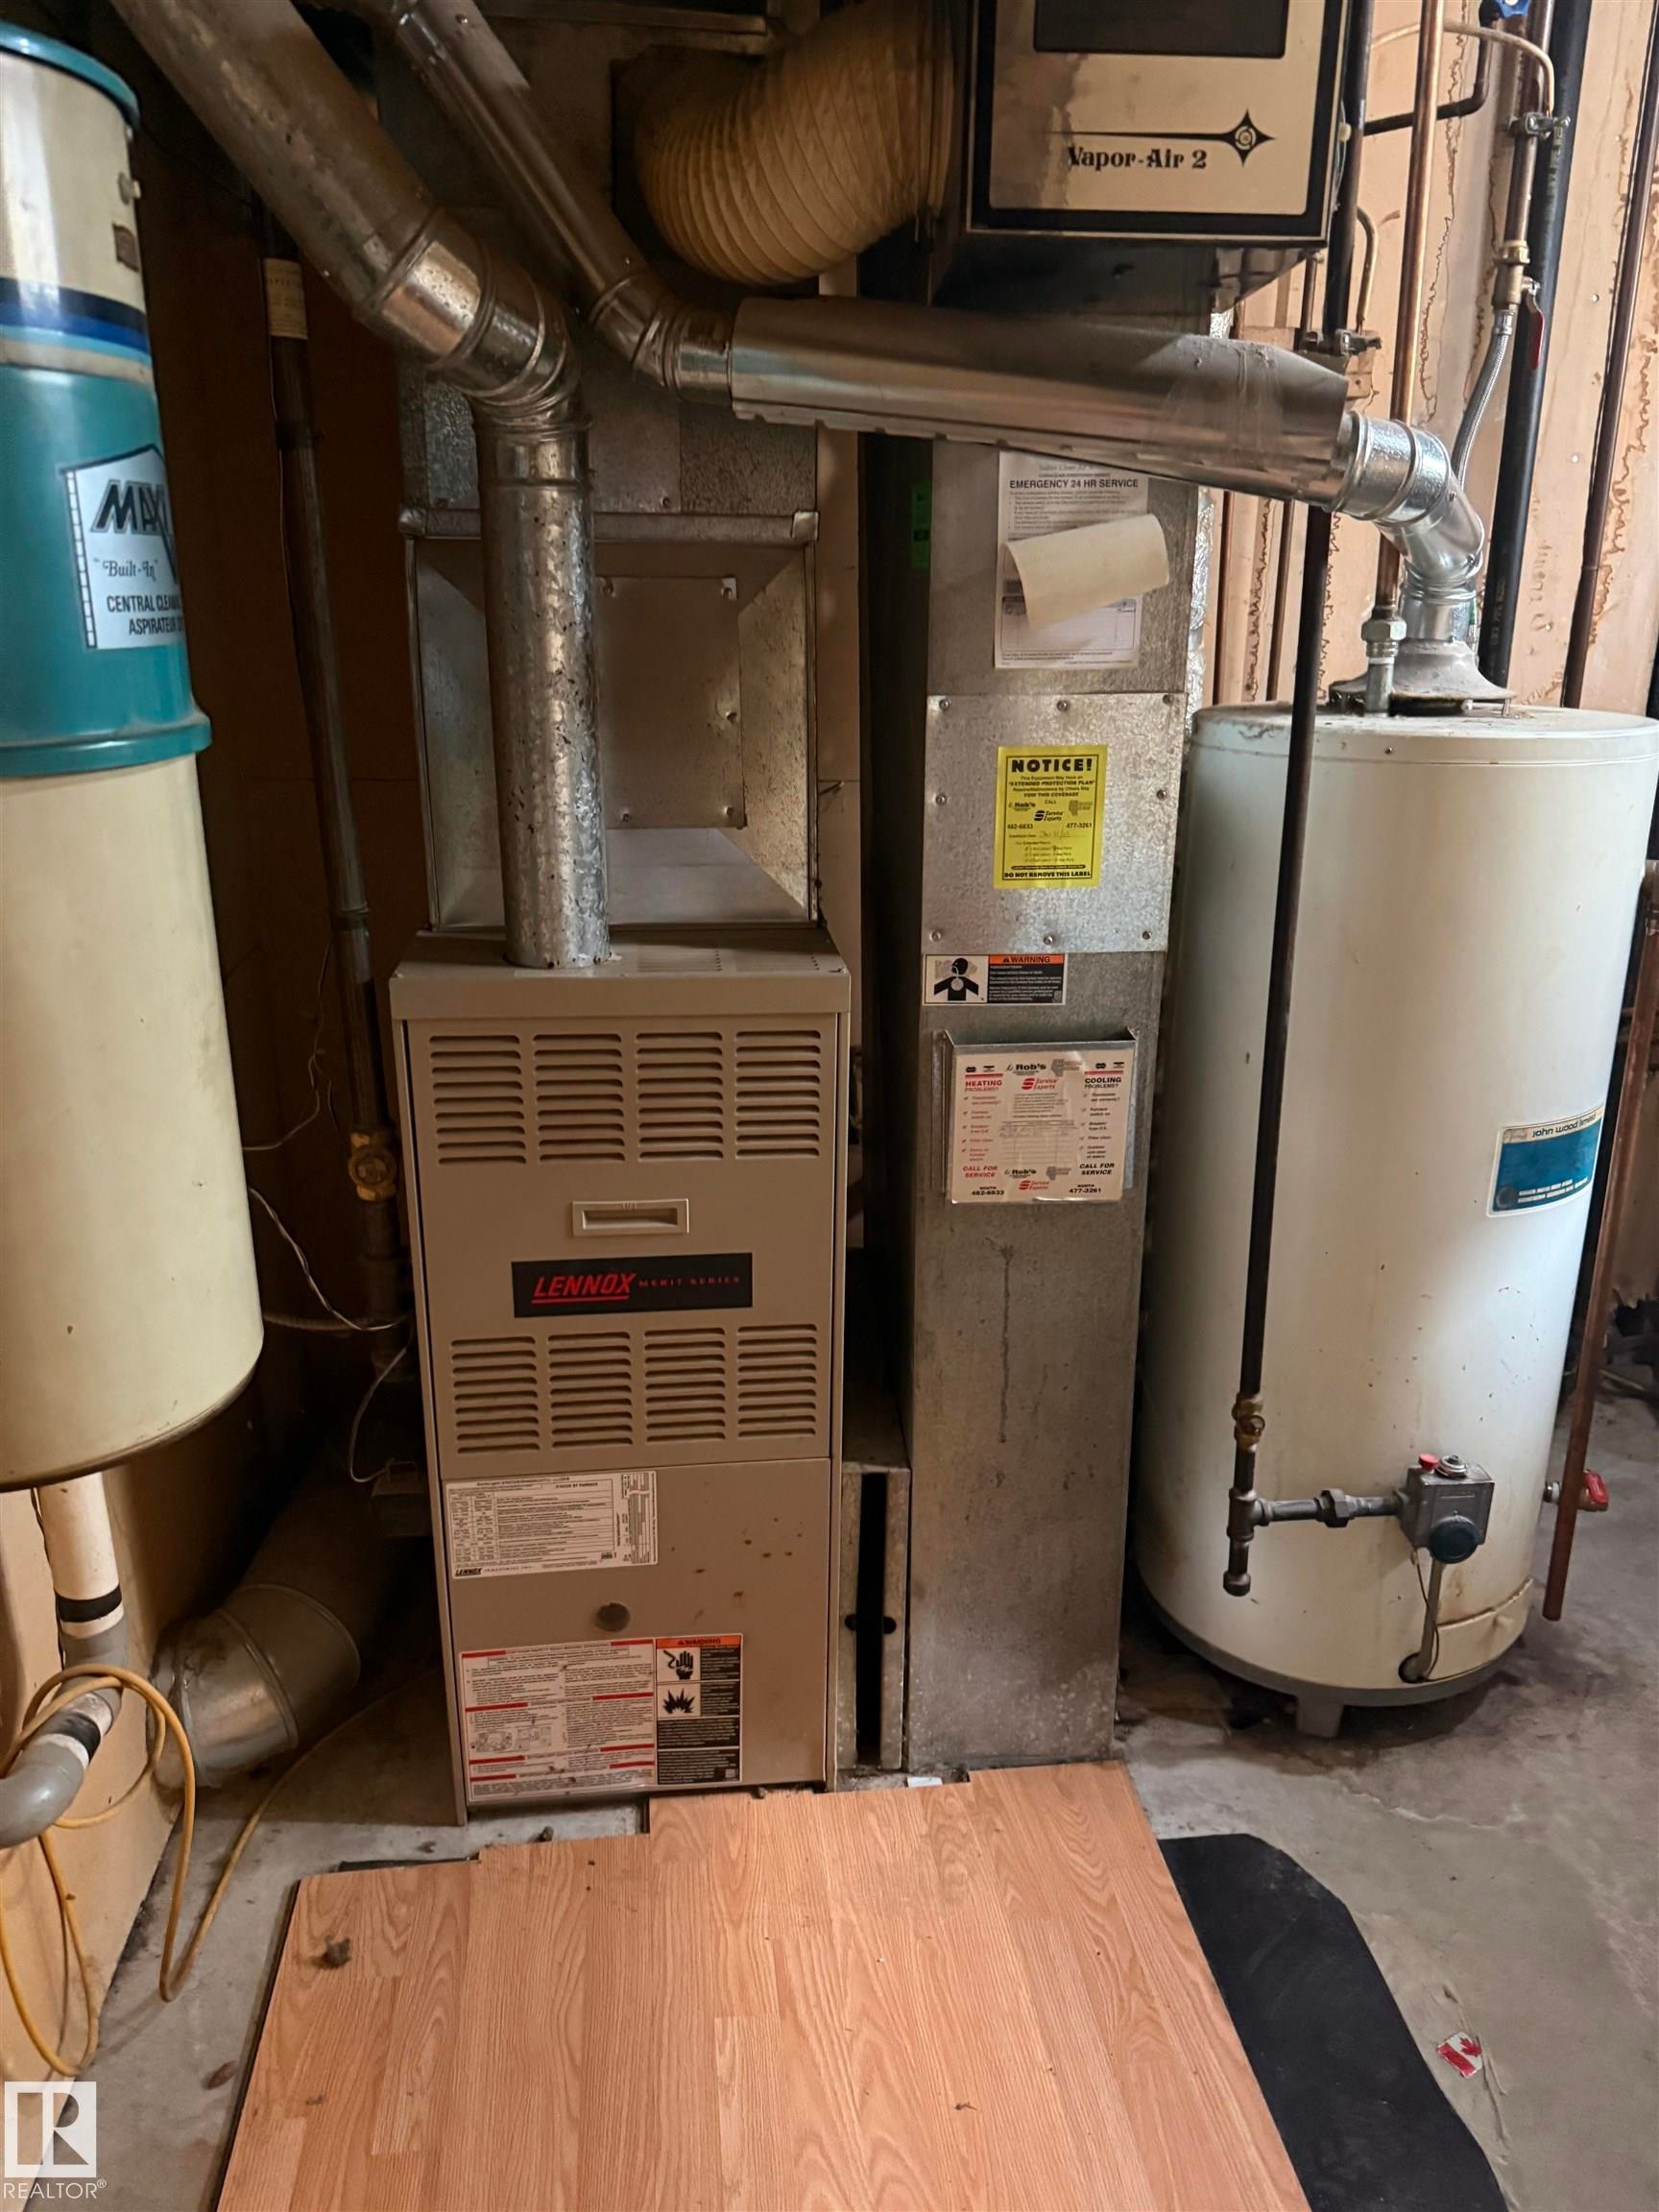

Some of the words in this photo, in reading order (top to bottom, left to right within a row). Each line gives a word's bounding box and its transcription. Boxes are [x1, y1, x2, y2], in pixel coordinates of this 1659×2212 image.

[1067, 145, 1185, 172] Vapor-Air
[1191, 149, 1208, 170] 2
[1009, 479, 1069, 490] EMERGENCY
[1070, 479, 1082, 489] 24
[1083, 479, 1097, 489] HR
[1098, 478, 1140, 489] SERVICE
[107, 594, 156, 613] CENTRAL
[1011, 757, 1093, 773] NOTICE!
[532, 1272, 637, 1299] LENNOX
